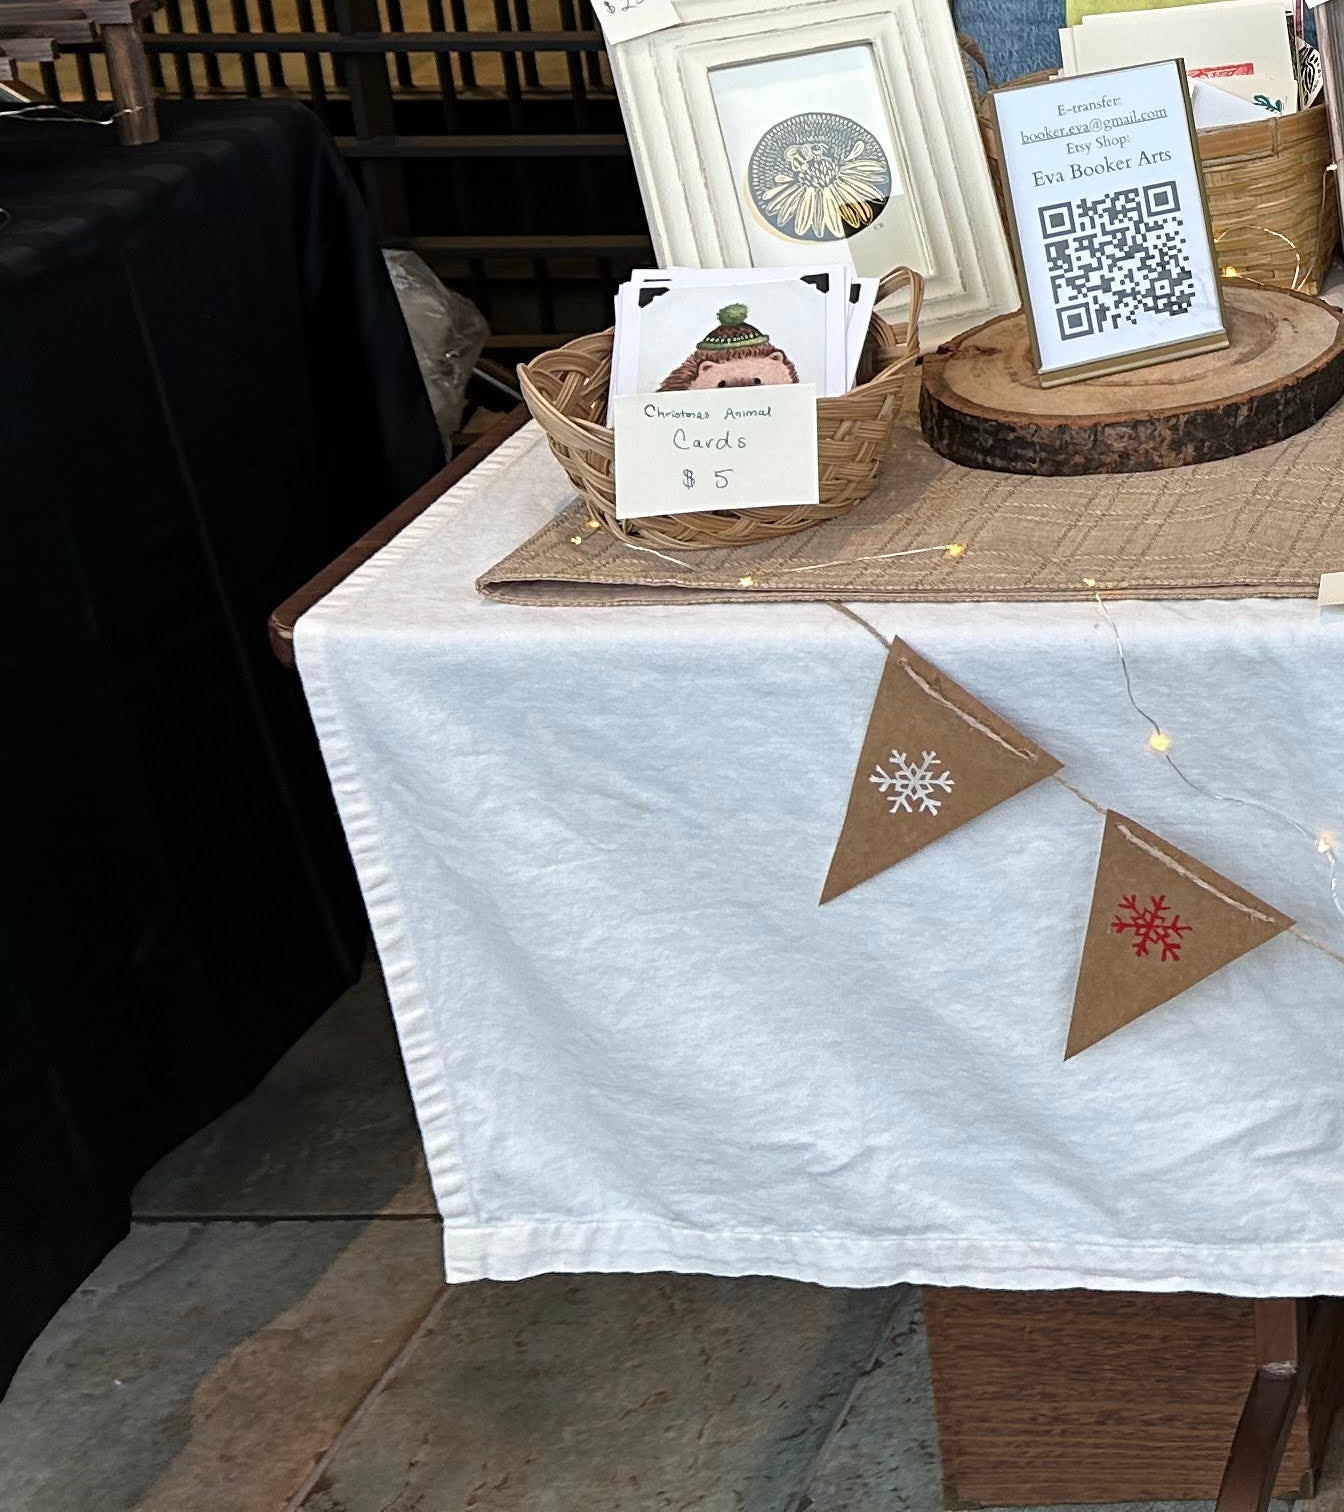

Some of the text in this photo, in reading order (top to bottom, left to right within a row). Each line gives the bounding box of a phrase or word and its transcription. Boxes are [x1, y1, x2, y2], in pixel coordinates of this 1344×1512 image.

[1057, 95, 1122, 116] E-transfer:
[1021, 107, 1168, 145] booker.eva@gmail.com
[1066, 134, 1131, 156] Etsy Shop:
[1032, 149, 1172, 187] Eva Booker Arts
[644, 404, 772, 421] Christmas Animal
[673, 428, 748, 450] Cards
